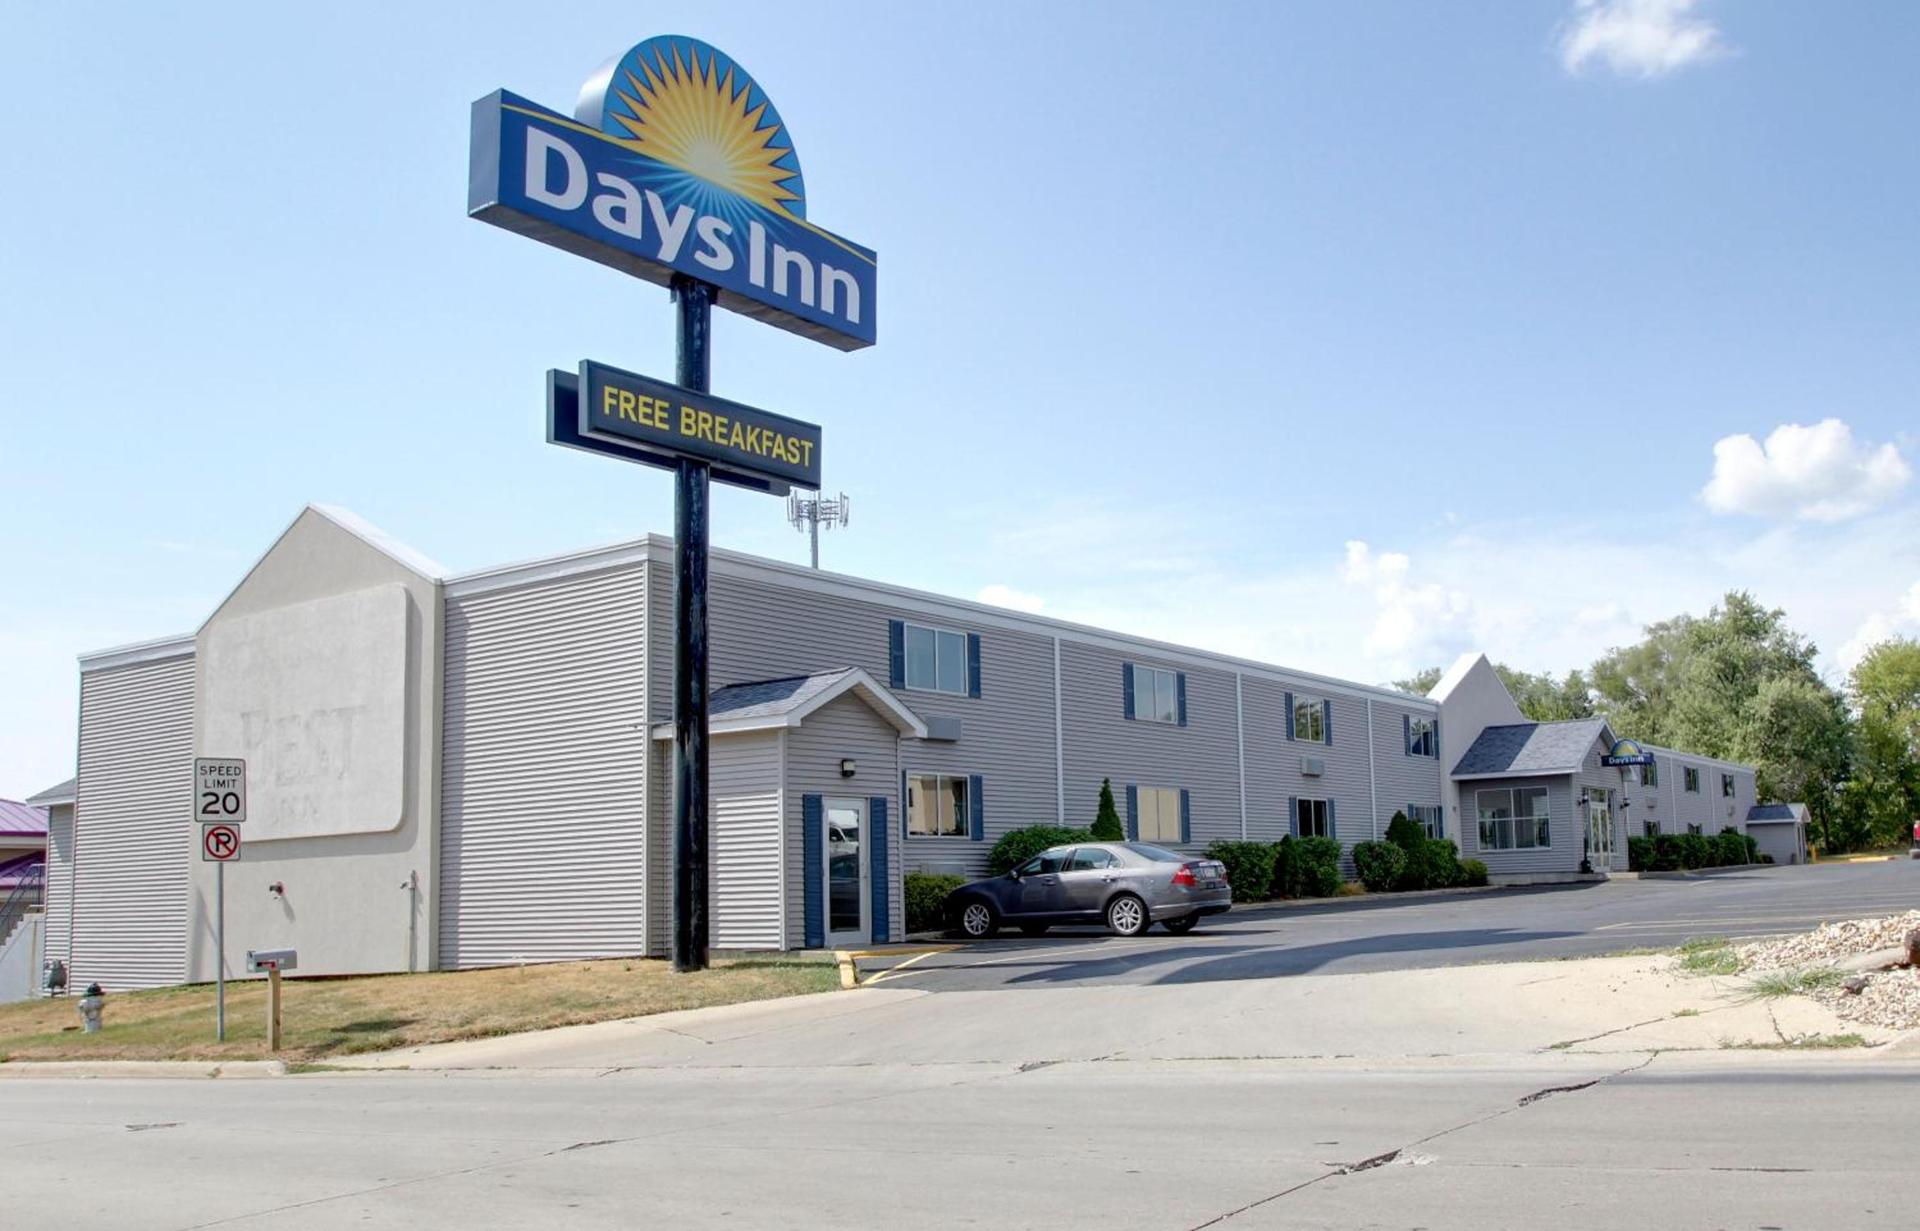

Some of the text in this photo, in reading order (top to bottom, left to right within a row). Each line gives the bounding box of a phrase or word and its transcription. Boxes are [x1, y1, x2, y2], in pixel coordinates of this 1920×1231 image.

[525, 125, 859, 324] Days Inn
[603, 385, 813, 467] FREE BREAKFAST
[200, 765, 242, 776] SPEED
[204, 779, 237, 789] LIMIT
[202, 792, 240, 814] 20
